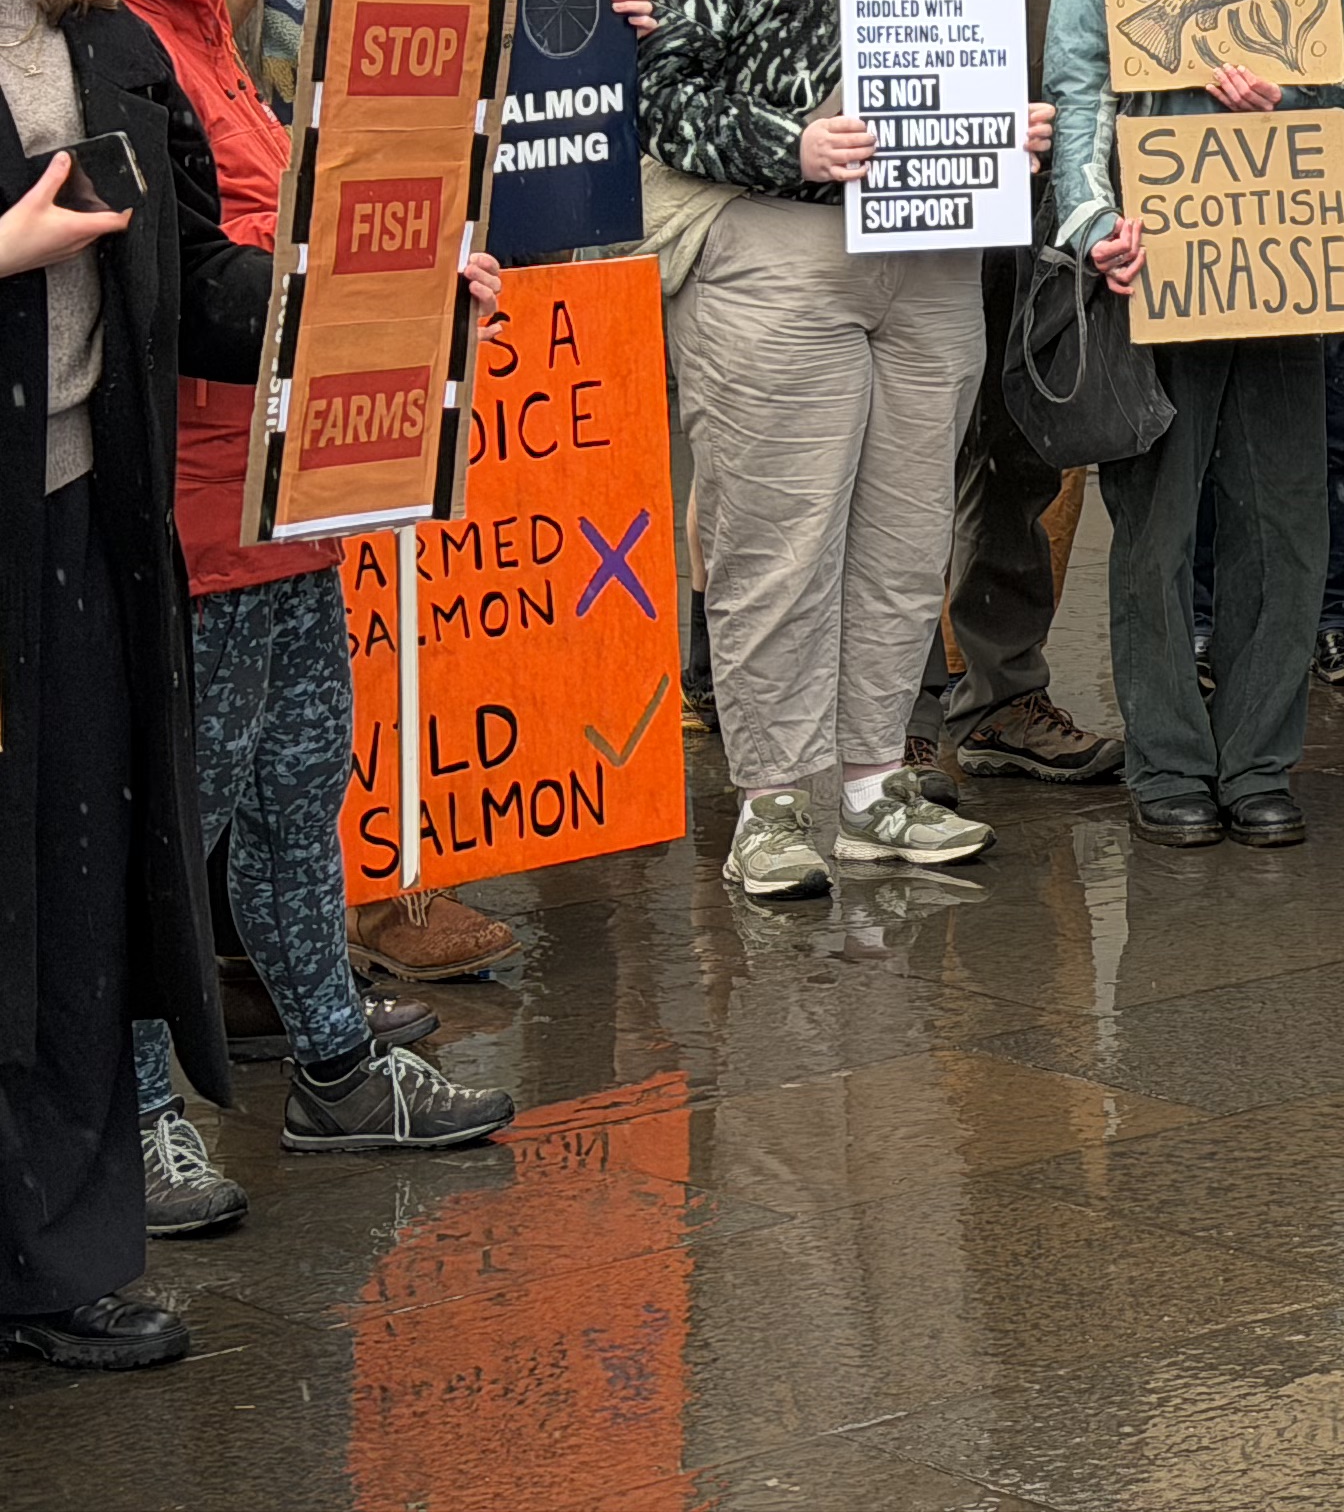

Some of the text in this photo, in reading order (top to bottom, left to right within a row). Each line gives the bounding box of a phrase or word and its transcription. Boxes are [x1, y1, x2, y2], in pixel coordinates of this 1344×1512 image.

[856, 0, 963, 18] RIDDLED WITH
[361, 25, 458, 77] STOP
[857, 24, 985, 45] SUFFERING, LICE,
[858, 49, 1007, 69] DISEASE AND DEATH
[862, 78, 937, 108] IS NOT
[867, 116, 1012, 148] AN INDUSTRY
[1138, 123, 1325, 185] SAVE
[866, 157, 994, 188] WE SHOULD
[350, 199, 431, 253] FISH
[865, 197, 969, 230] SUPPORT
[1140, 189, 1344, 235] SCOTTISH
[549, 300, 580, 368] A
[303, 389, 425, 450] FARMS
